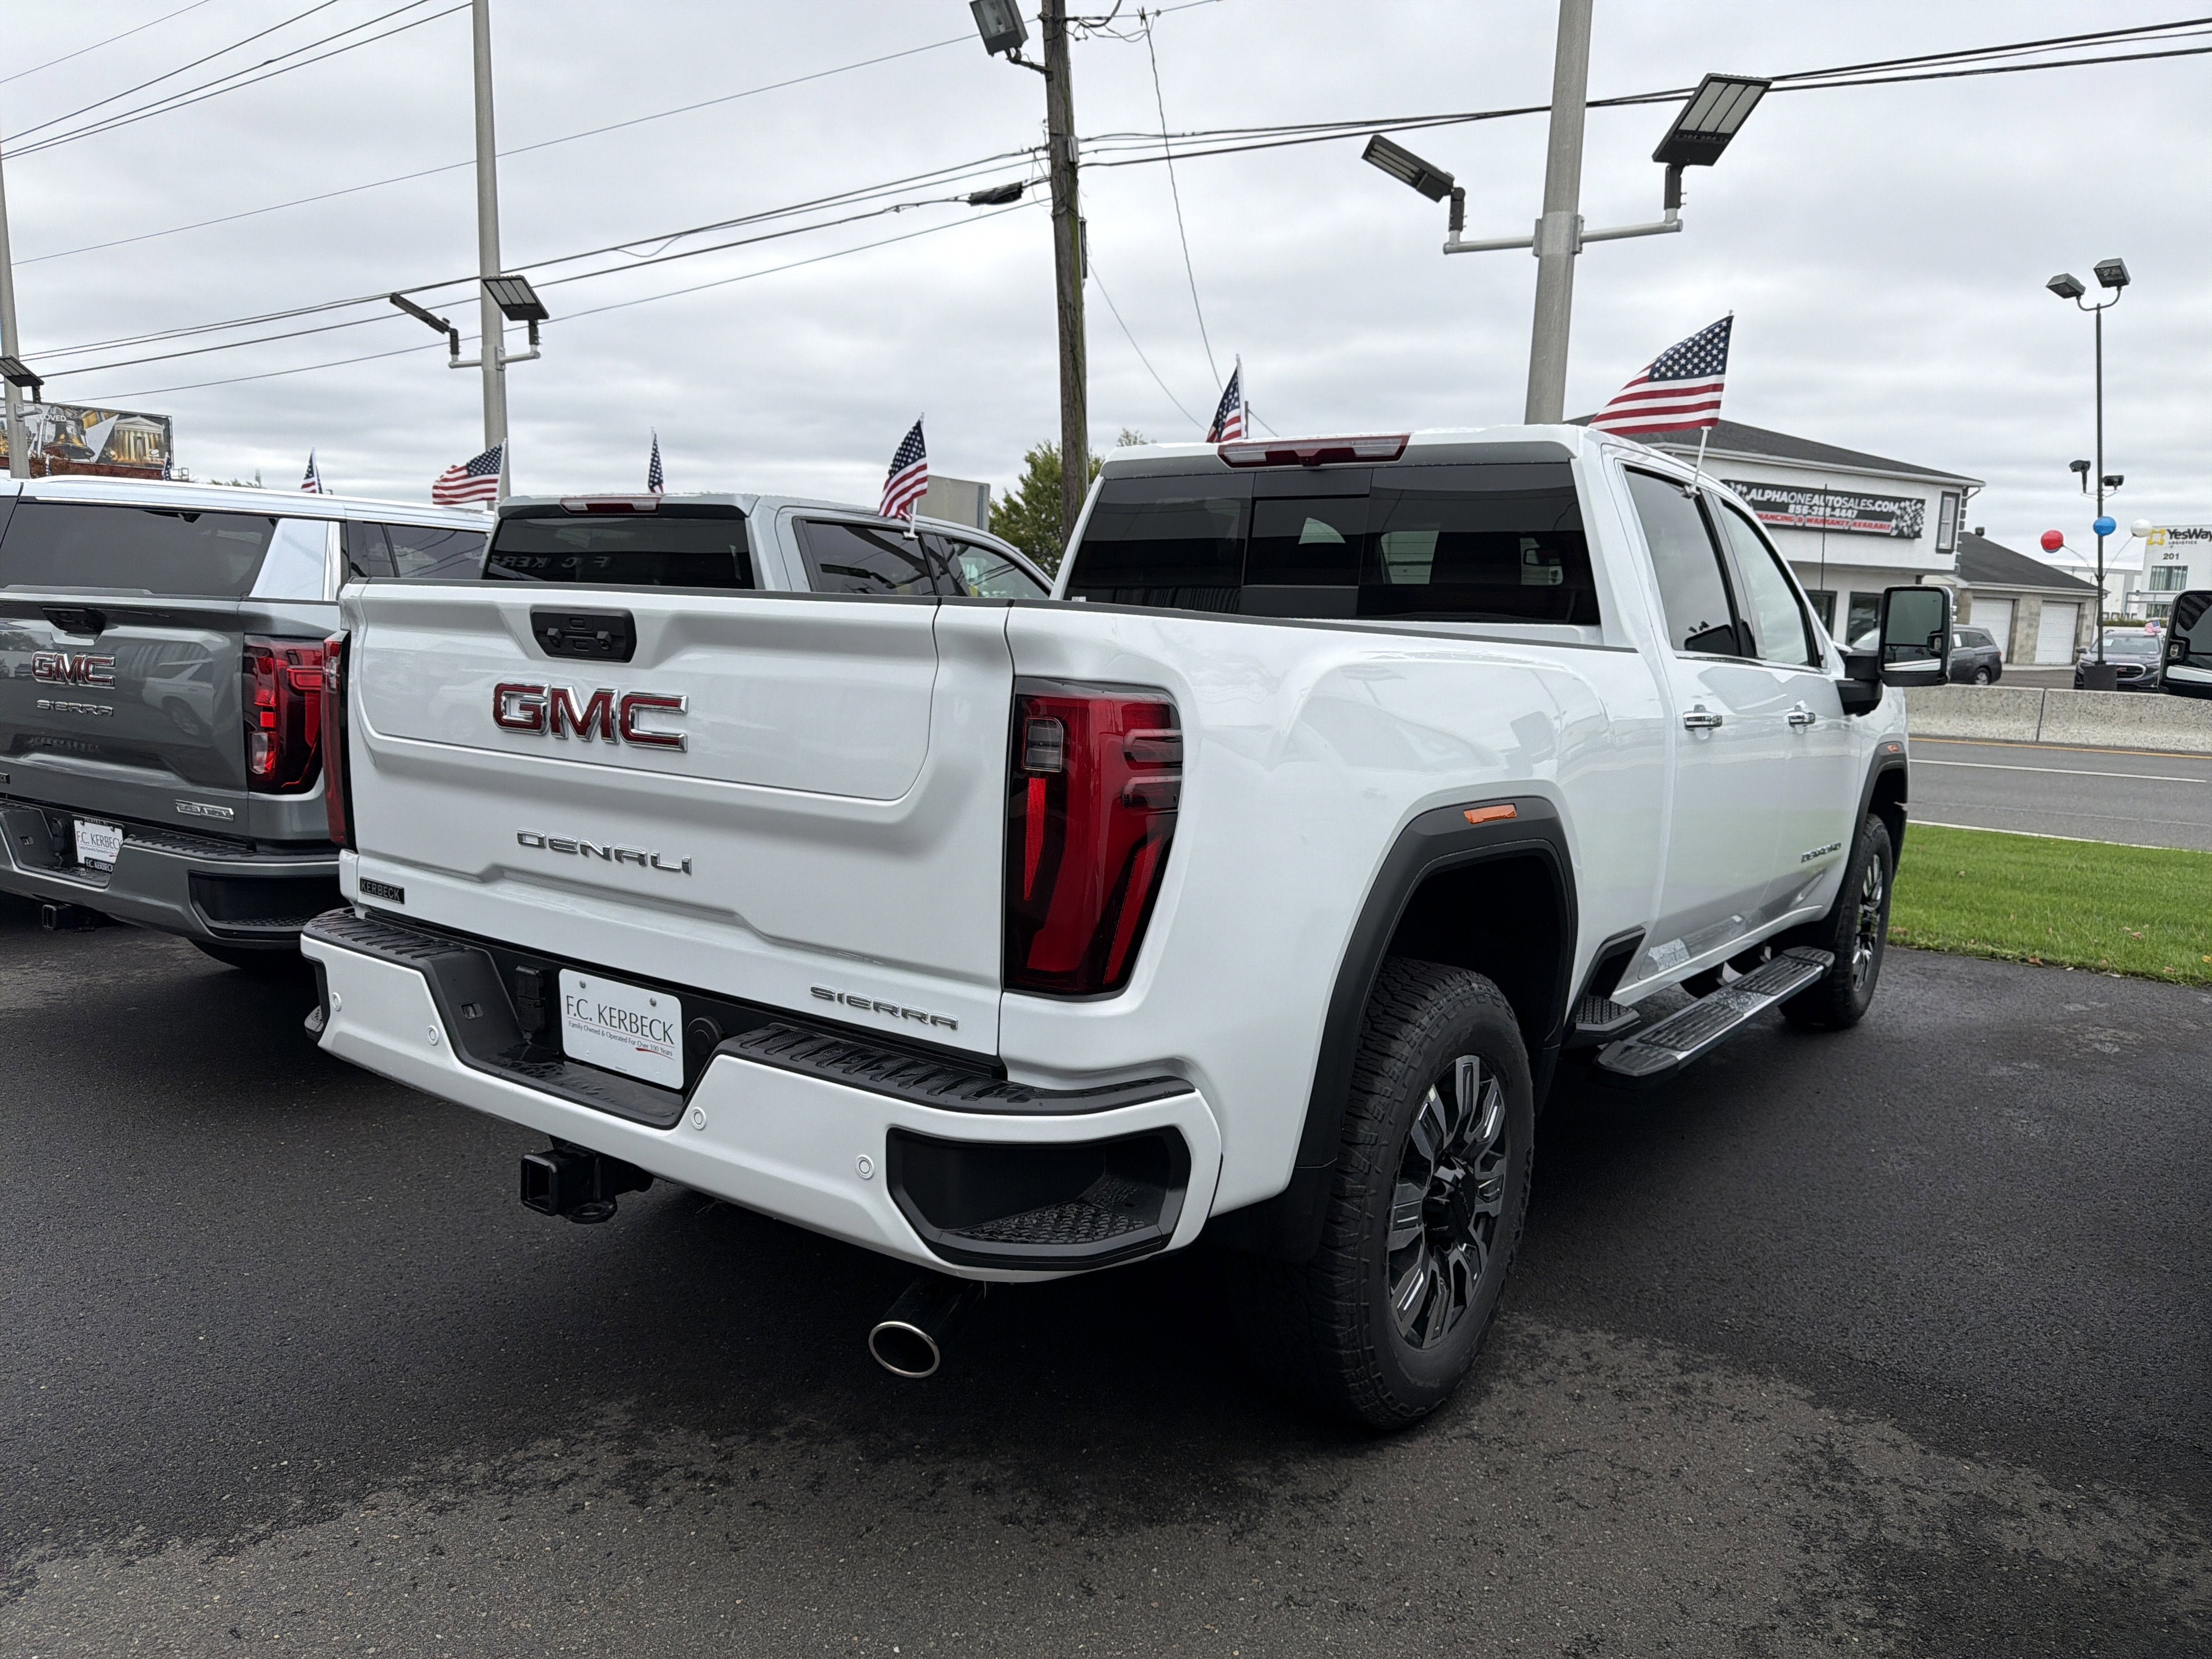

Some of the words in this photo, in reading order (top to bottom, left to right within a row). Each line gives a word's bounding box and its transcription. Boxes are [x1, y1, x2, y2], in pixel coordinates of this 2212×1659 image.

[1747, 489, 1899, 512] ALPHAONEAUTOSALES.COM
[31, 650, 116, 690] GMC
[36, 699, 114, 716] SIERRA
[493, 680, 689, 753] GMC
[77, 831, 90, 844] F.C.
[91, 833, 122, 850] KERBECK
[517, 828, 692, 877] DENALI
[361, 879, 400, 901] KERBECK
[566, 995, 592, 1022] F.C.
[597, 1003, 675, 1045] KERBECK
[810, 984, 958, 1030] SIERRA
[568, 1020, 583, 1031] Family
[583, 1024, 601, 1036] Owned
[606, 1031, 628, 1043] Operated
[628, 1037, 636, 1046] For
[636, 1040, 648, 1049] Over
[650, 1043, 659, 1052] 100
[660, 1046, 673, 1057] Years
